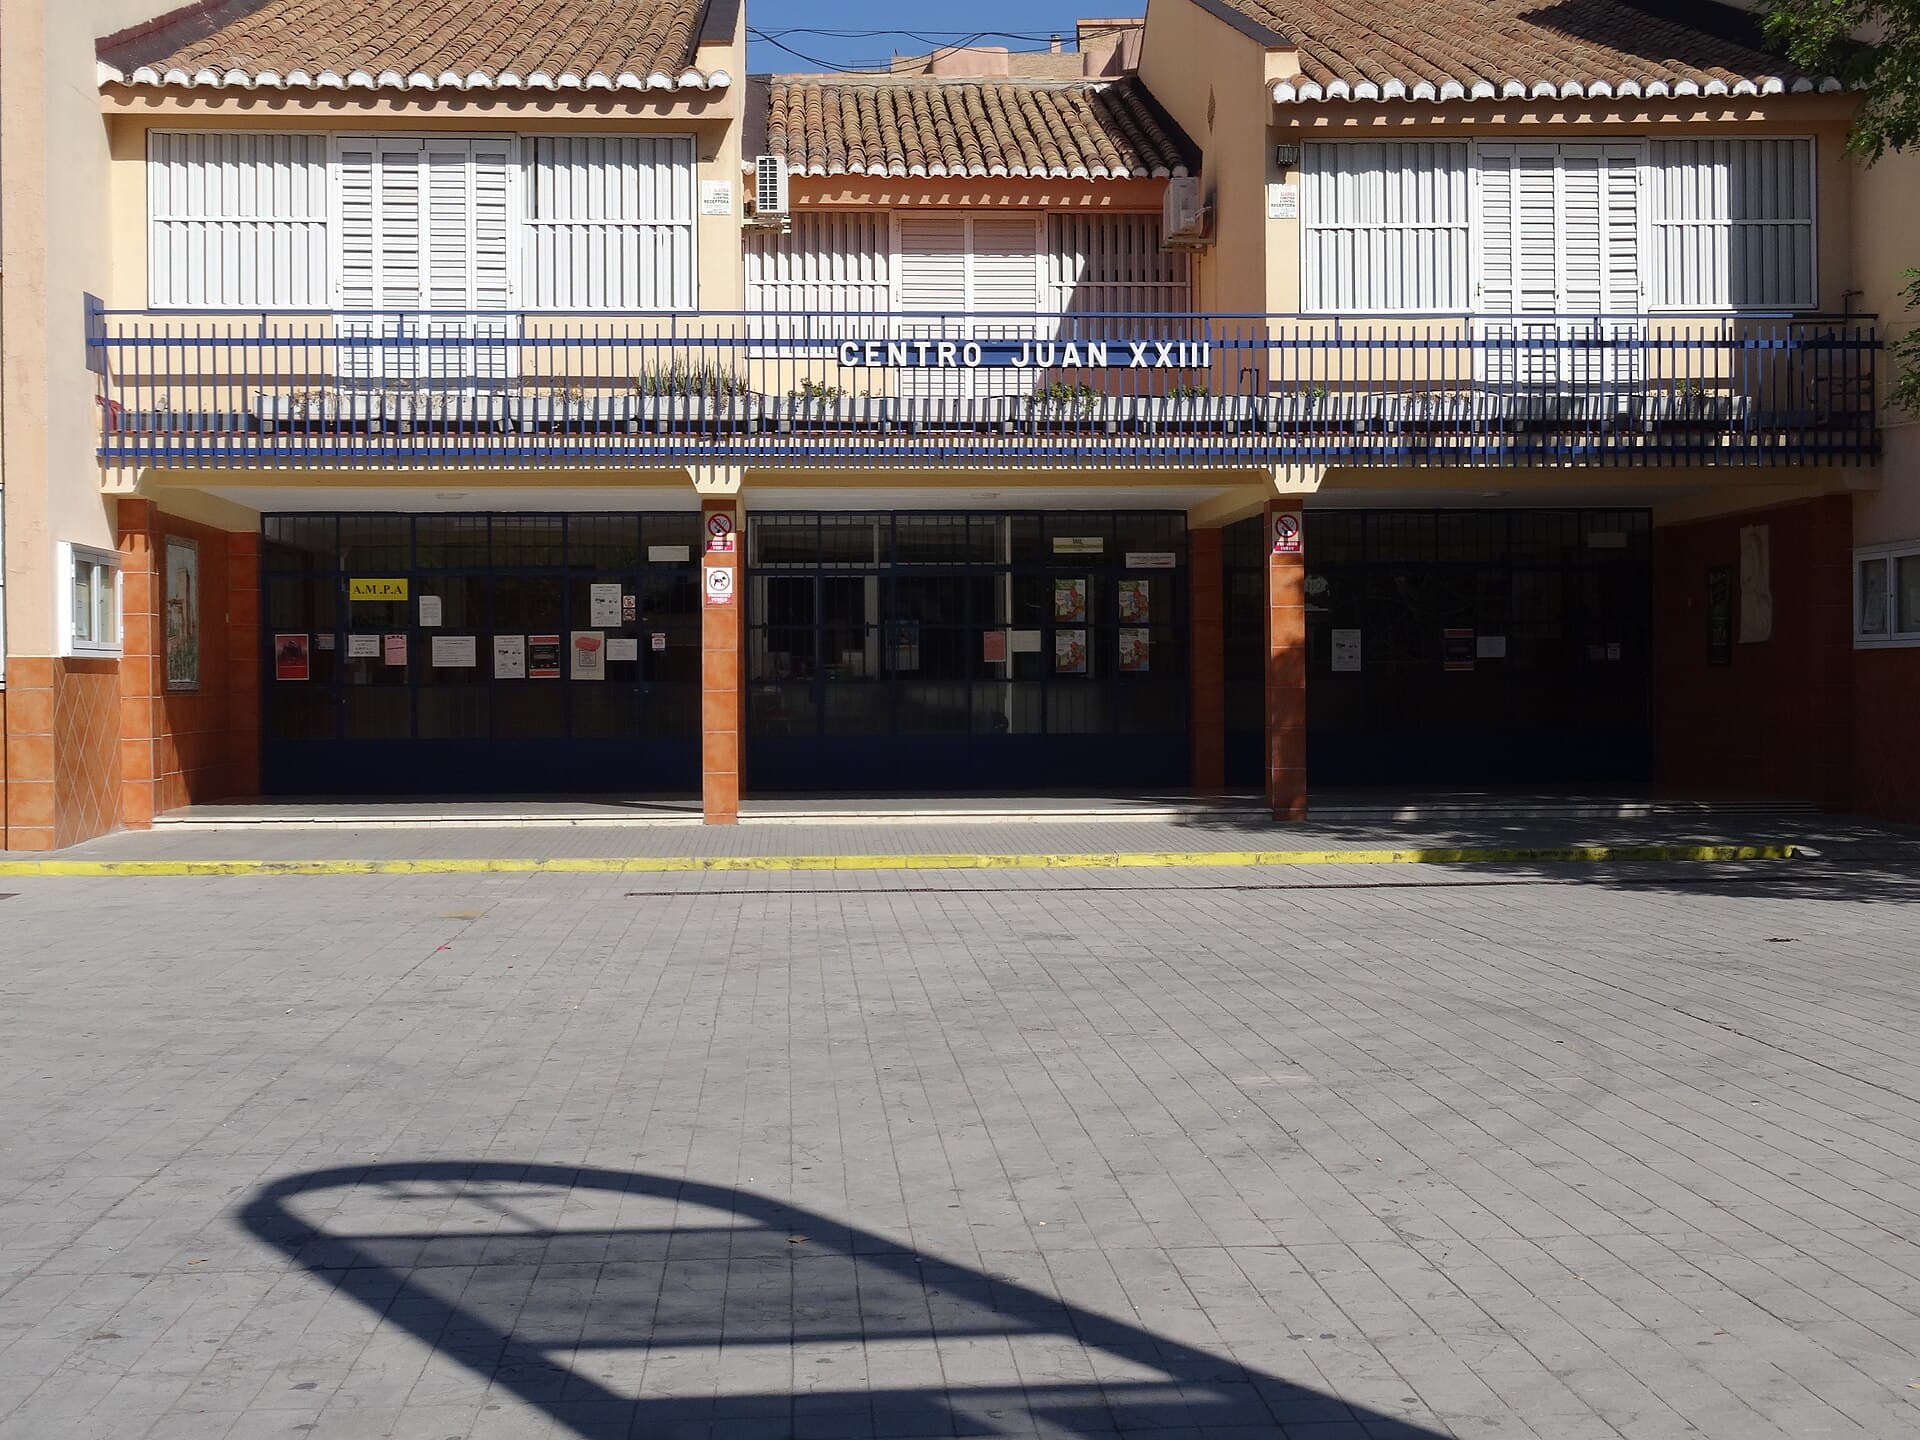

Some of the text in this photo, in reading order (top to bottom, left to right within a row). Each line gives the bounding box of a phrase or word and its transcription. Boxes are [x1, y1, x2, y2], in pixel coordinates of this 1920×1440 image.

[840, 342, 1209, 368] CENTRO JUAN XXIII
